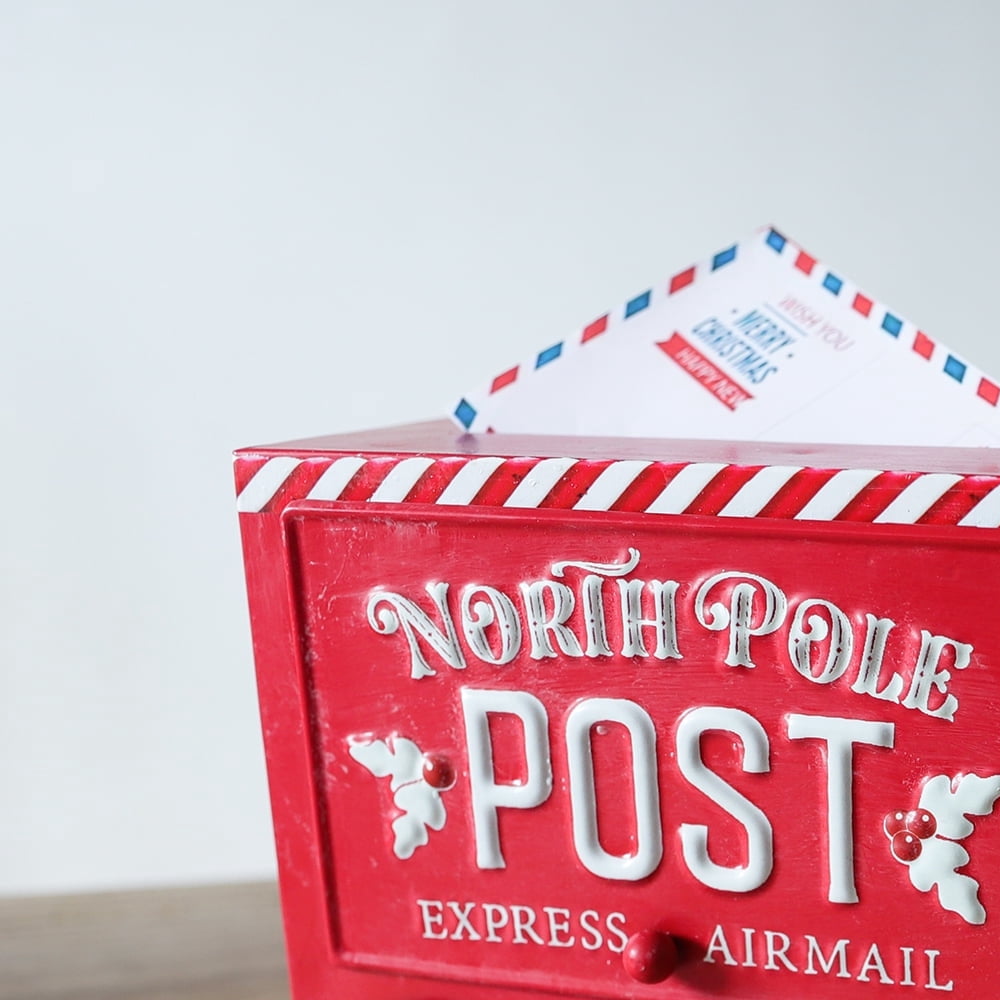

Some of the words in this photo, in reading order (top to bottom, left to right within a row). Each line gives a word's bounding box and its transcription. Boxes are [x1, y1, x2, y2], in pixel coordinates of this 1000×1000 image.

[692, 316, 778, 384] CHRISTMAS
[734, 309, 796, 354] MERRY
[821, 321, 856, 351] YOU
[366, 547, 683, 680] NORTH
[694, 570, 974, 723] POLE
[461, 687, 896, 904] POST
[416, 899, 628, 953] EXPRESS
[702, 924, 955, 991] AIRMAIL
